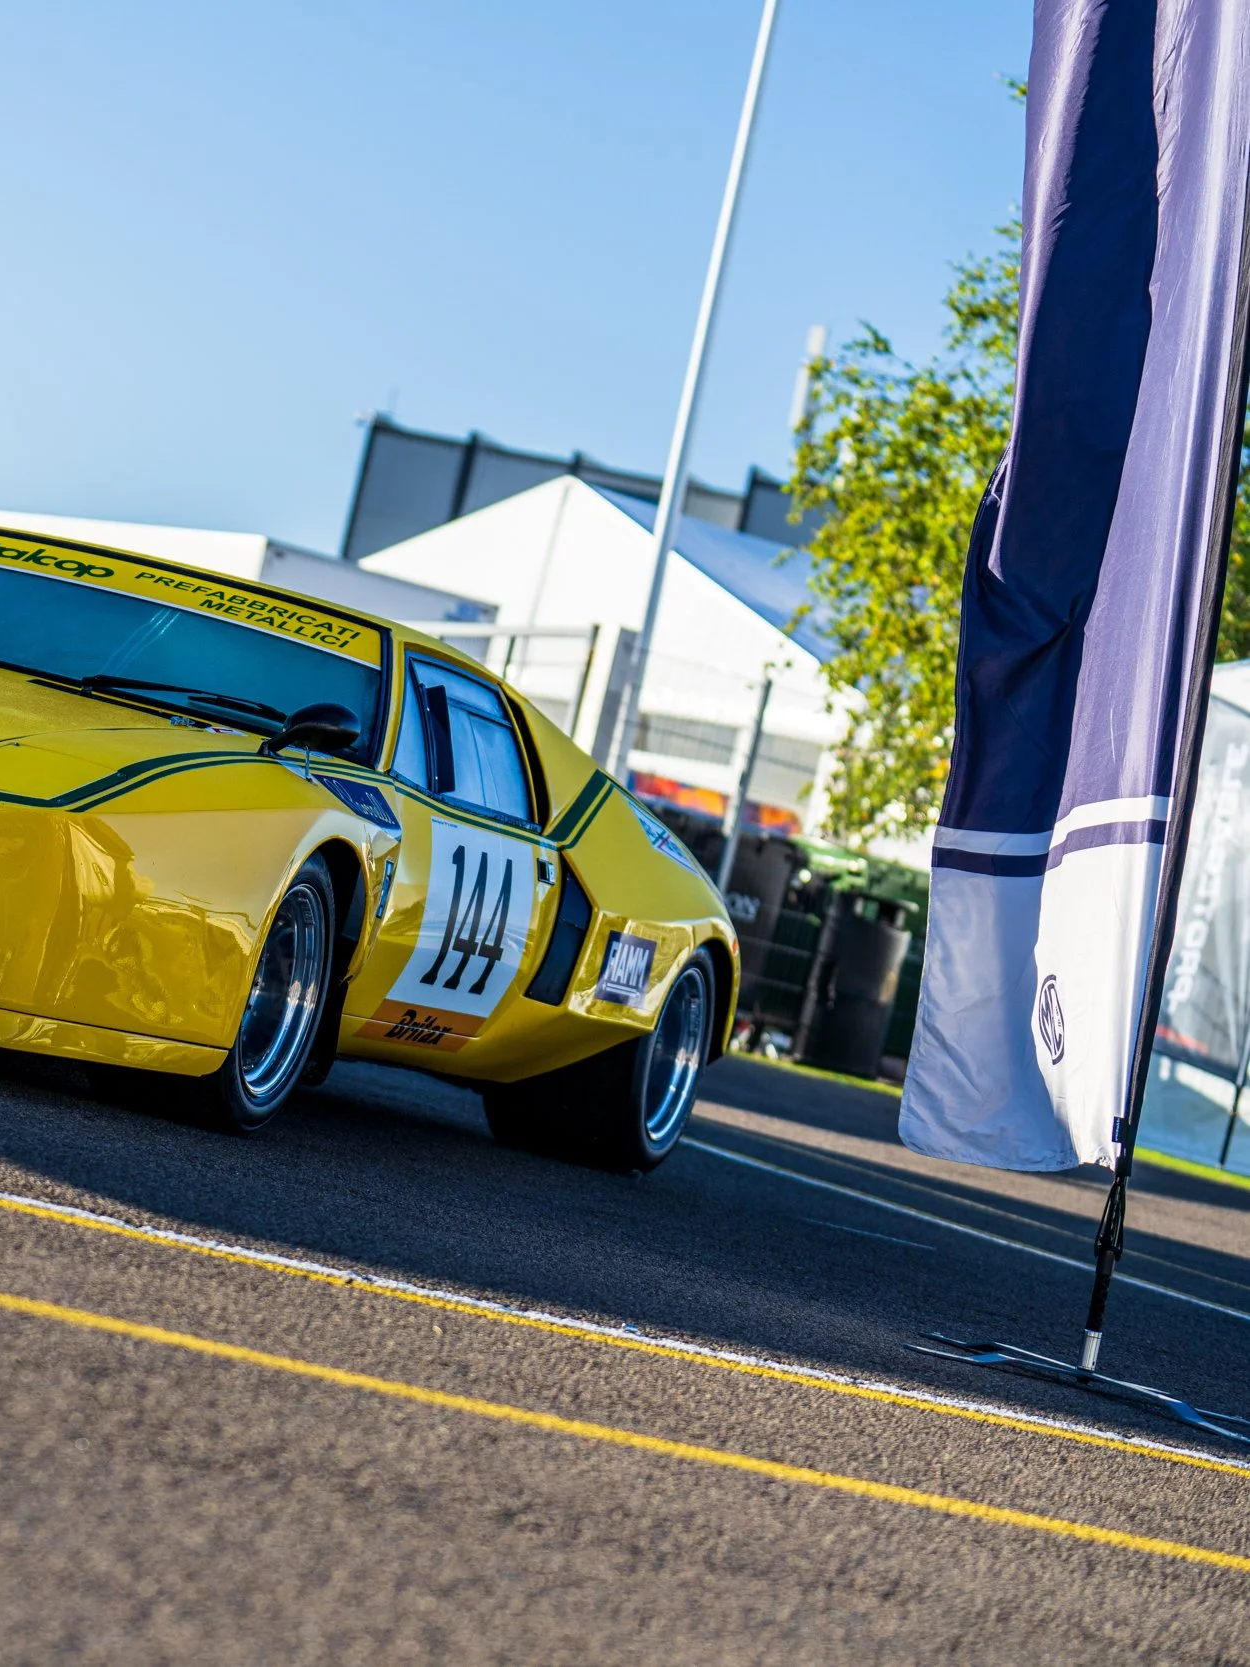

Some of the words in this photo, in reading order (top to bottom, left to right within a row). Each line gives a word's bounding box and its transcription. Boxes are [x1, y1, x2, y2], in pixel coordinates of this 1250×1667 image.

[134, 571, 362, 640] PREFABBRICATI
[199, 599, 350, 649] METALLICI
[419, 845, 513, 995] 144
[604, 940, 649, 989] FIAMM
[384, 1008, 453, 1046] Britax
